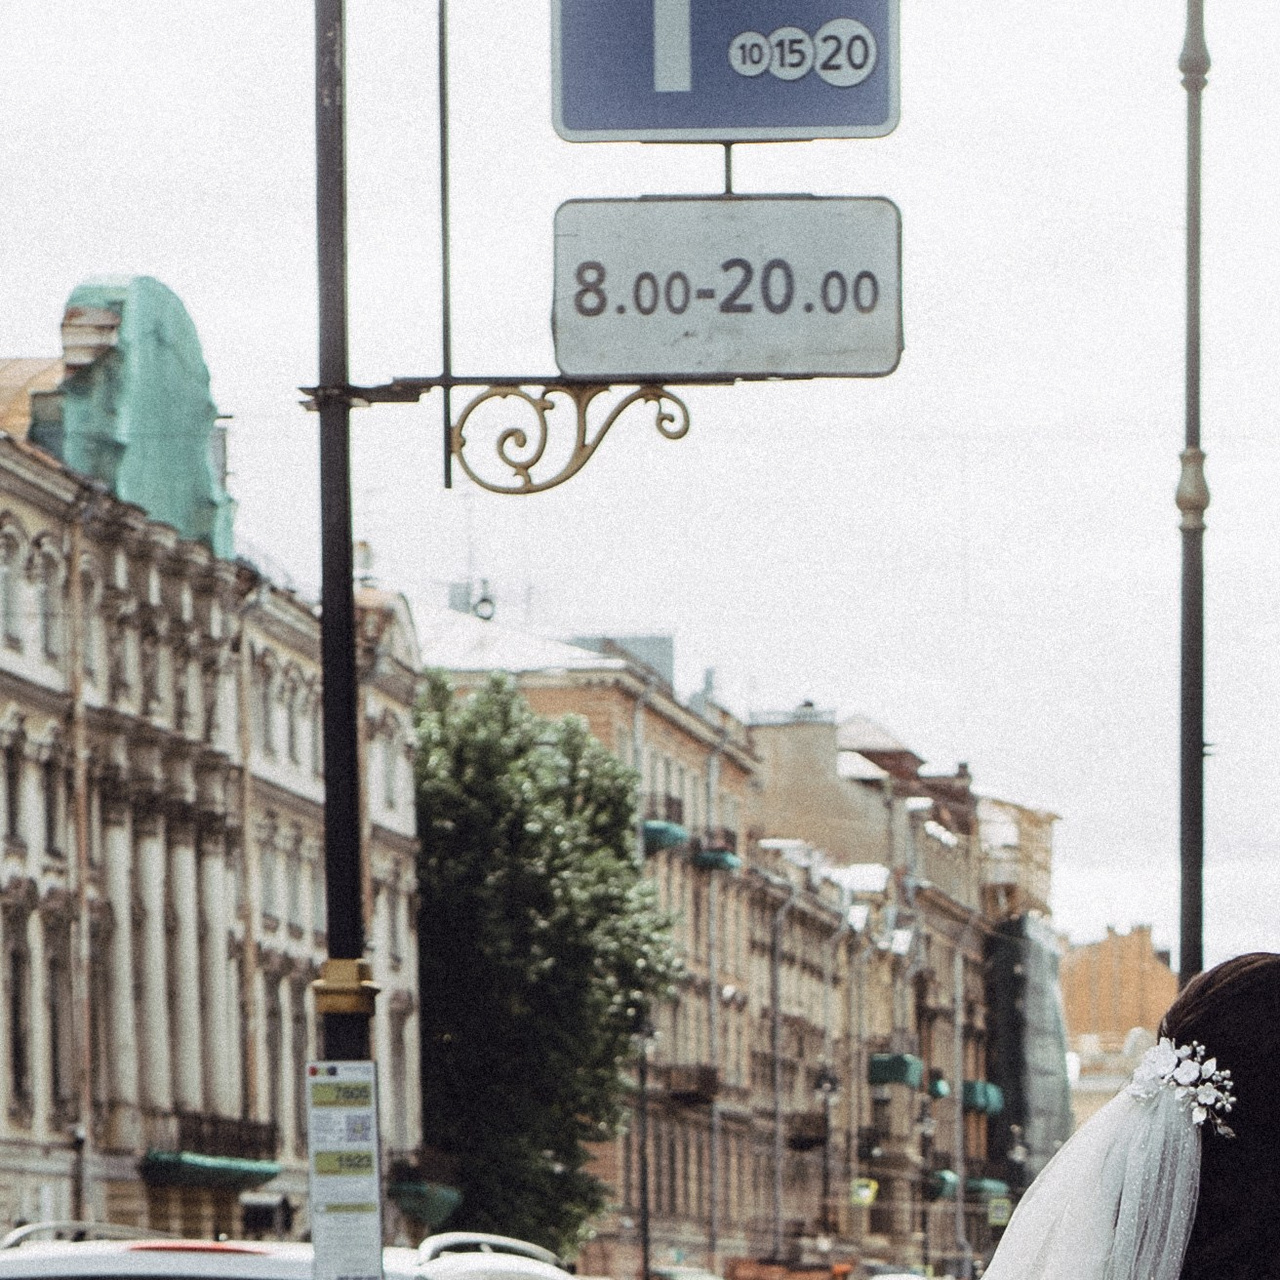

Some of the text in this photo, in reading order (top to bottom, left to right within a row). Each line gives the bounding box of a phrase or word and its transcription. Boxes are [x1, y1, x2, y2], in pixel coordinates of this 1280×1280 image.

[739, 34, 869, 70] 10 15 20
[573, 258, 880, 317] 8.00-20.00
